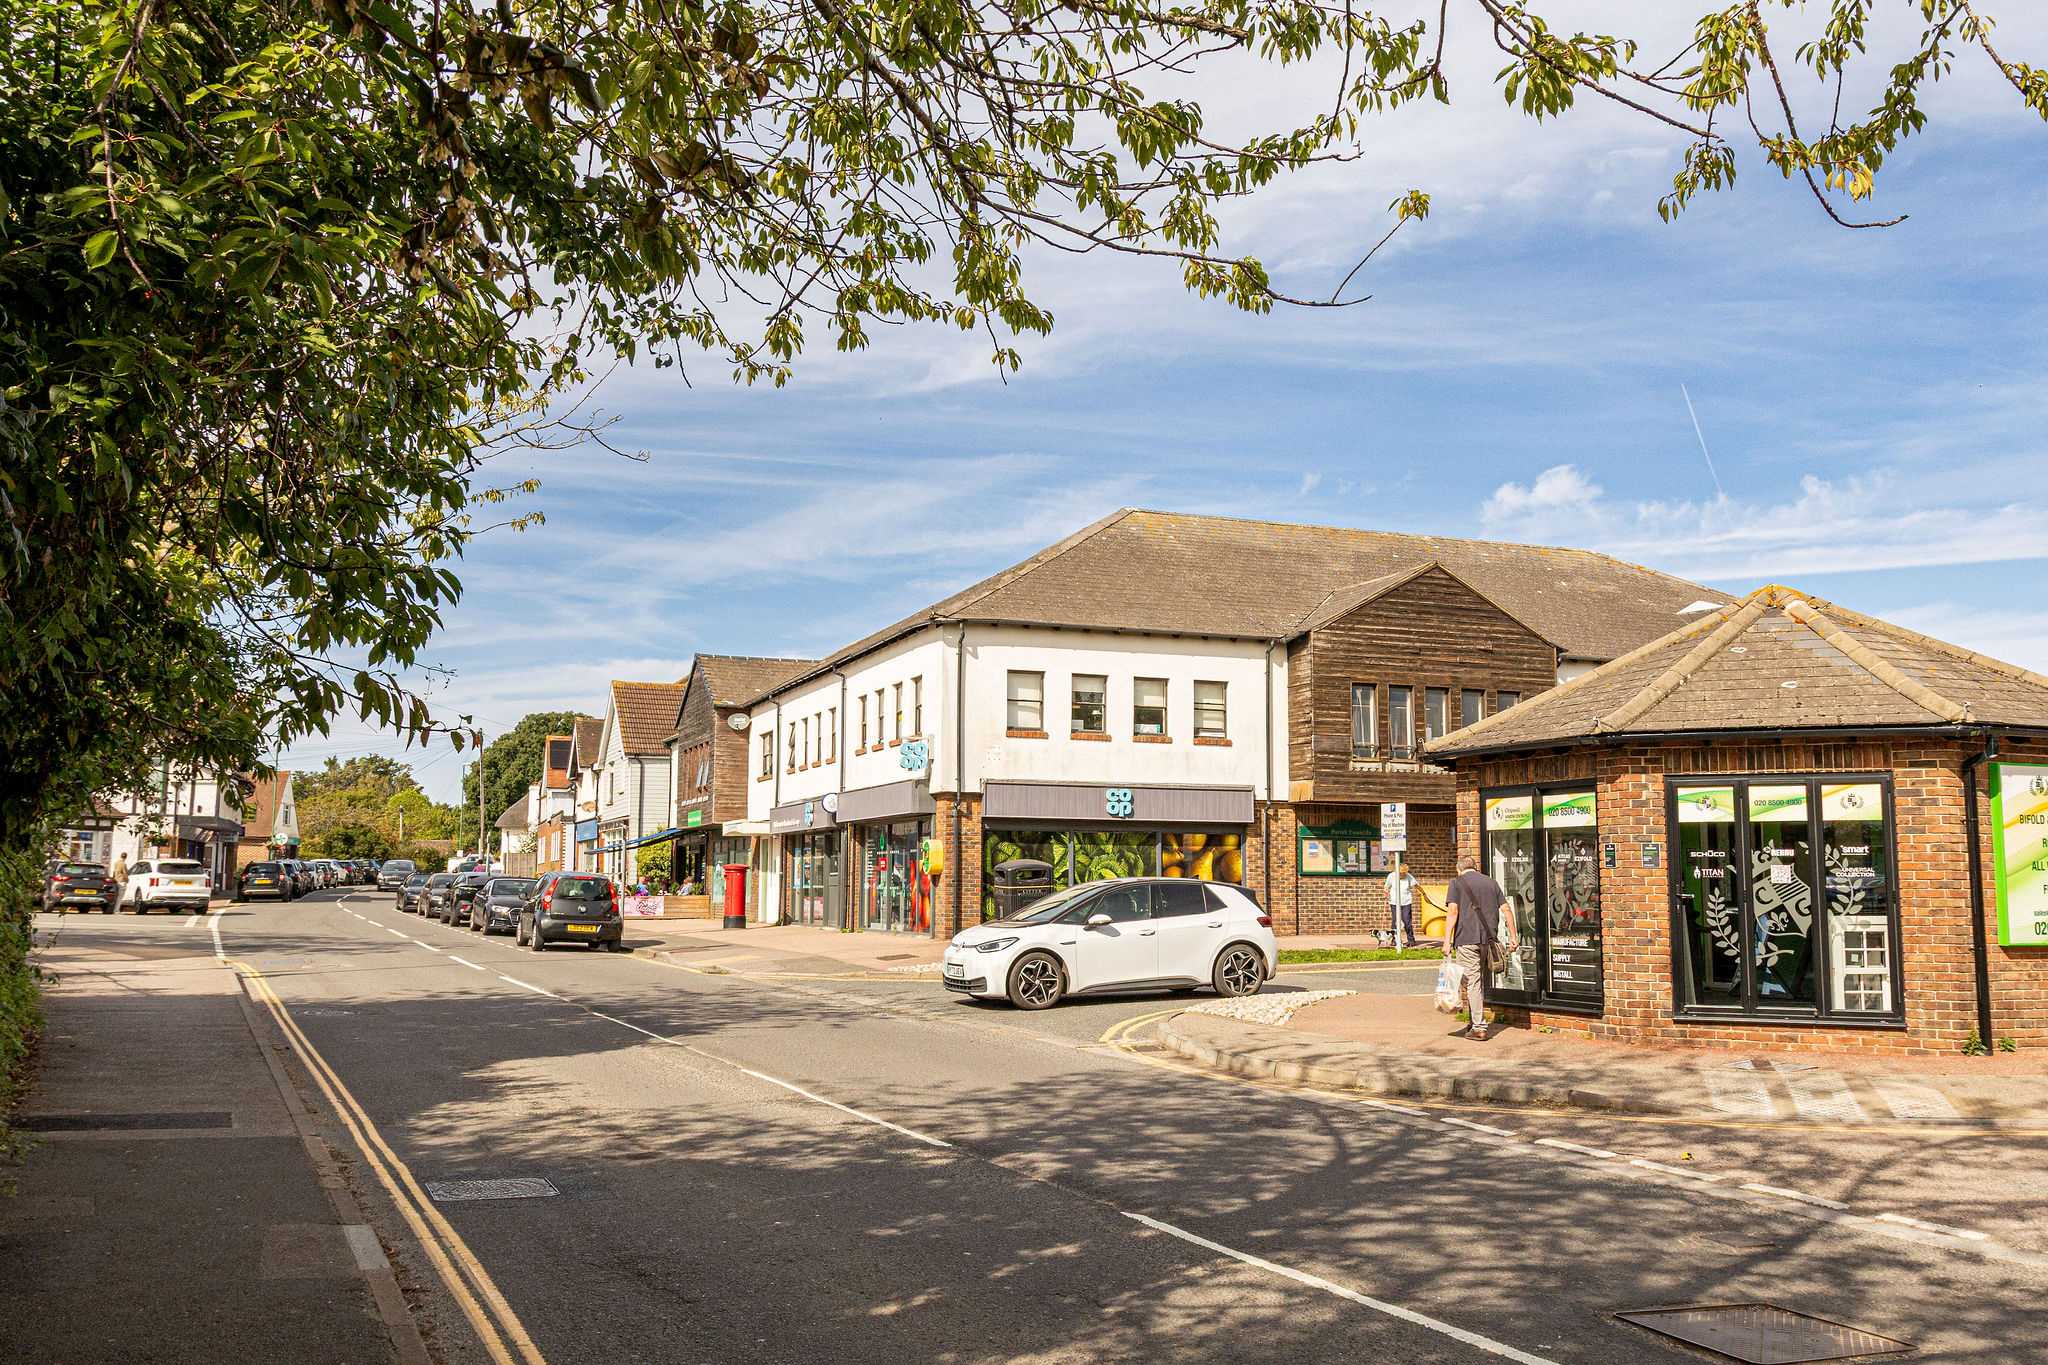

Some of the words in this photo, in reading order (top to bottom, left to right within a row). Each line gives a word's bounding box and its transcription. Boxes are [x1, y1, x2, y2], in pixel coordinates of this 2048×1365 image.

[1548, 807, 1559, 817] 020
[1560, 806, 1575, 816] 8500
[2019, 814, 2045, 824] BIFOLD
[1690, 849, 1726, 857] SCHÜCO
[2032, 860, 2046, 871] ALL
[1701, 868, 1725, 876] TITAN
[1552, 938, 1589, 947] MANUFACTURE
[1552, 954, 1571, 963] SUPPLY
[1552, 970, 1574, 979] INSTALL
